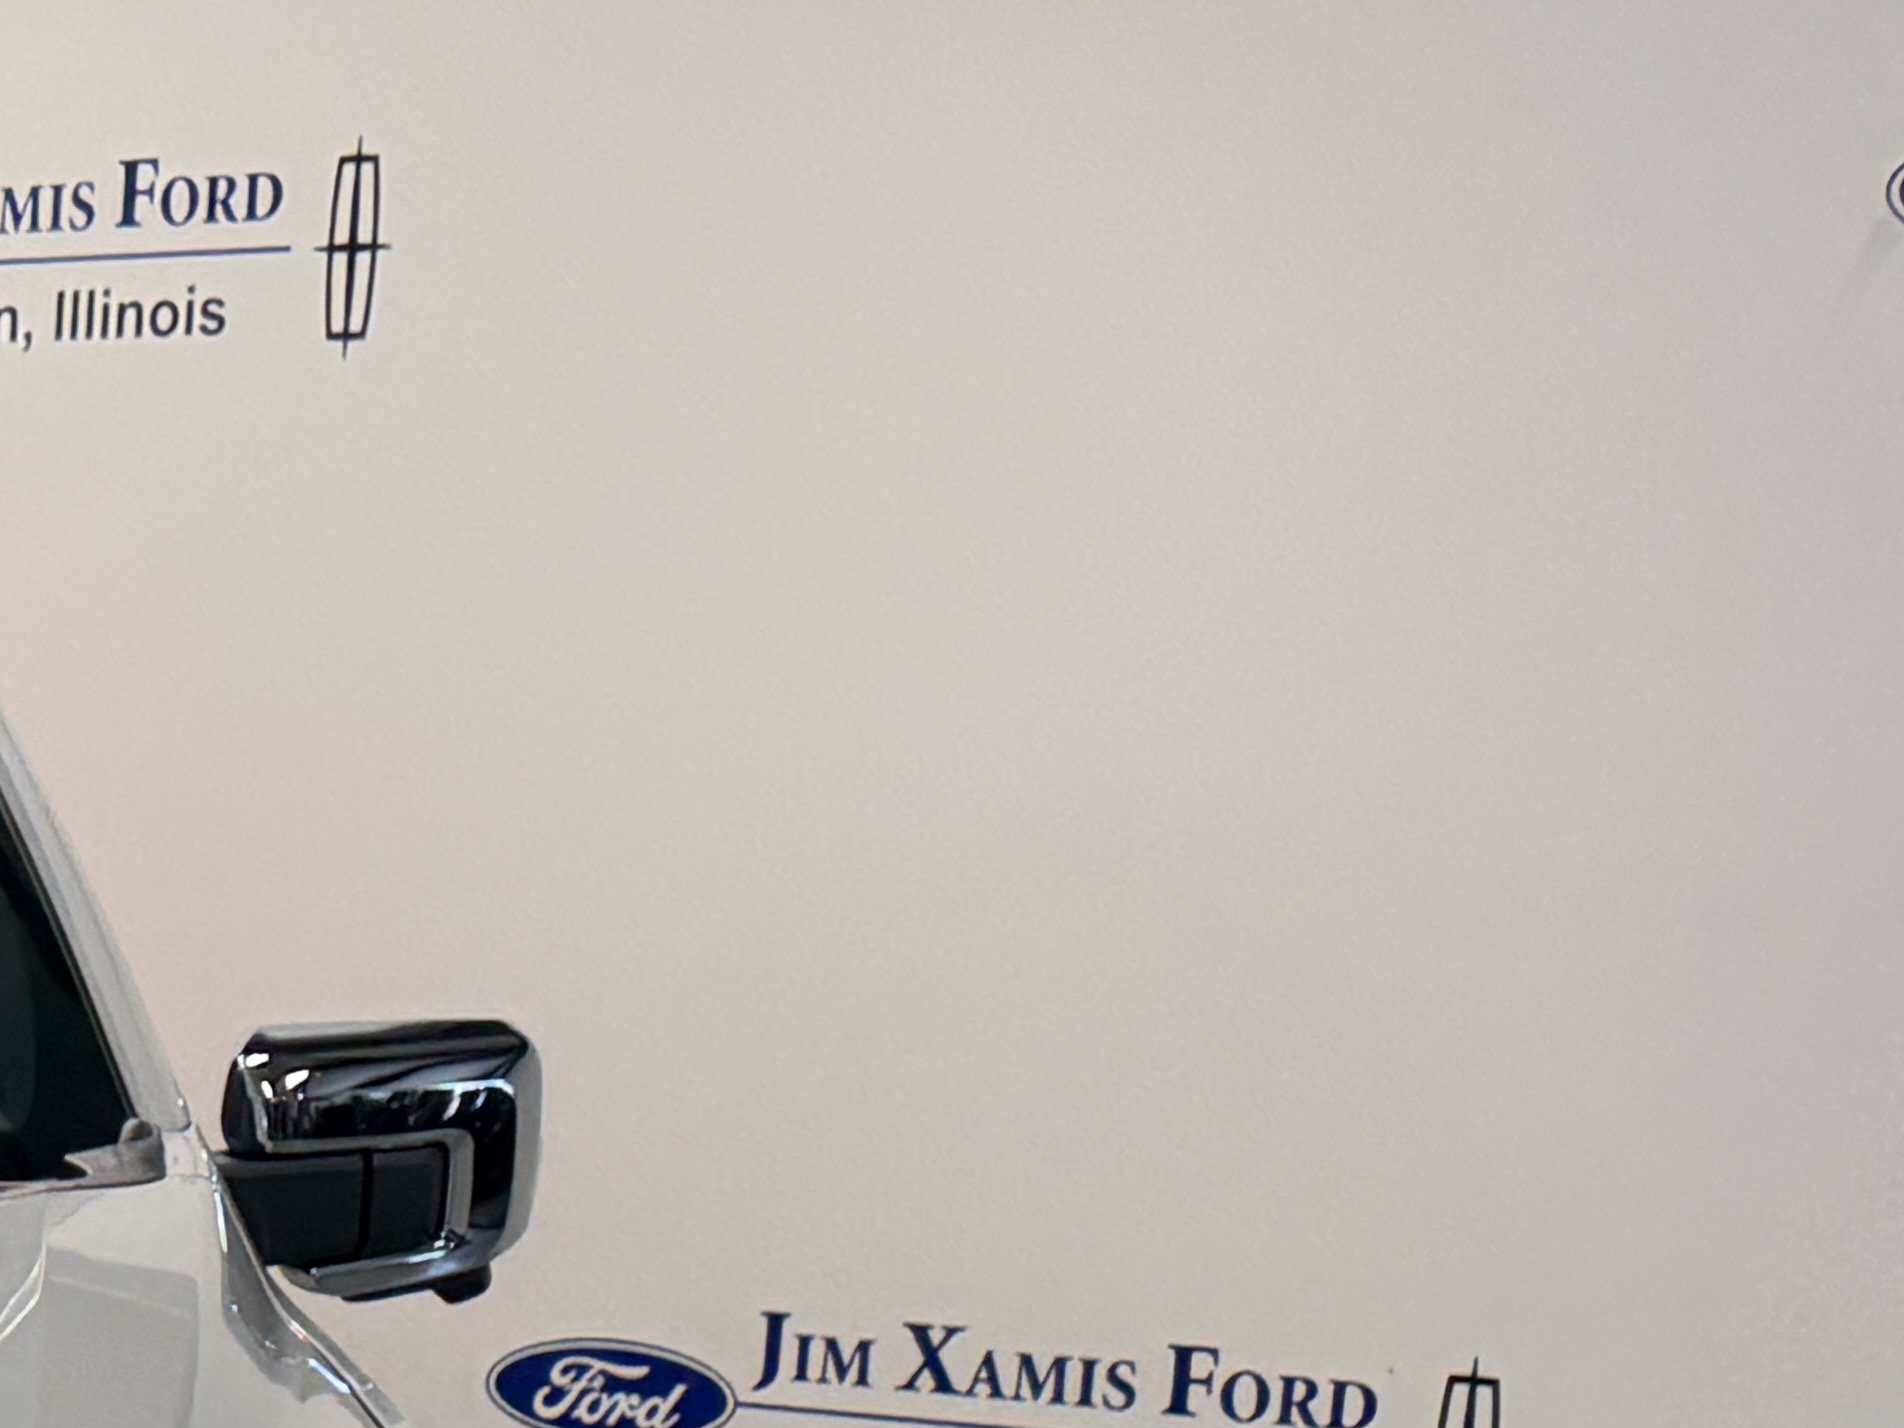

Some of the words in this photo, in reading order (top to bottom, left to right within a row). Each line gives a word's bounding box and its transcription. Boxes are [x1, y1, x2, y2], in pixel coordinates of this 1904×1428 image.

[115, 157, 284, 229] FORD
[54, 284, 227, 341] Illinois
[752, 1311, 874, 1392] JIM
[895, 1322, 1137, 1412] XAMIS
